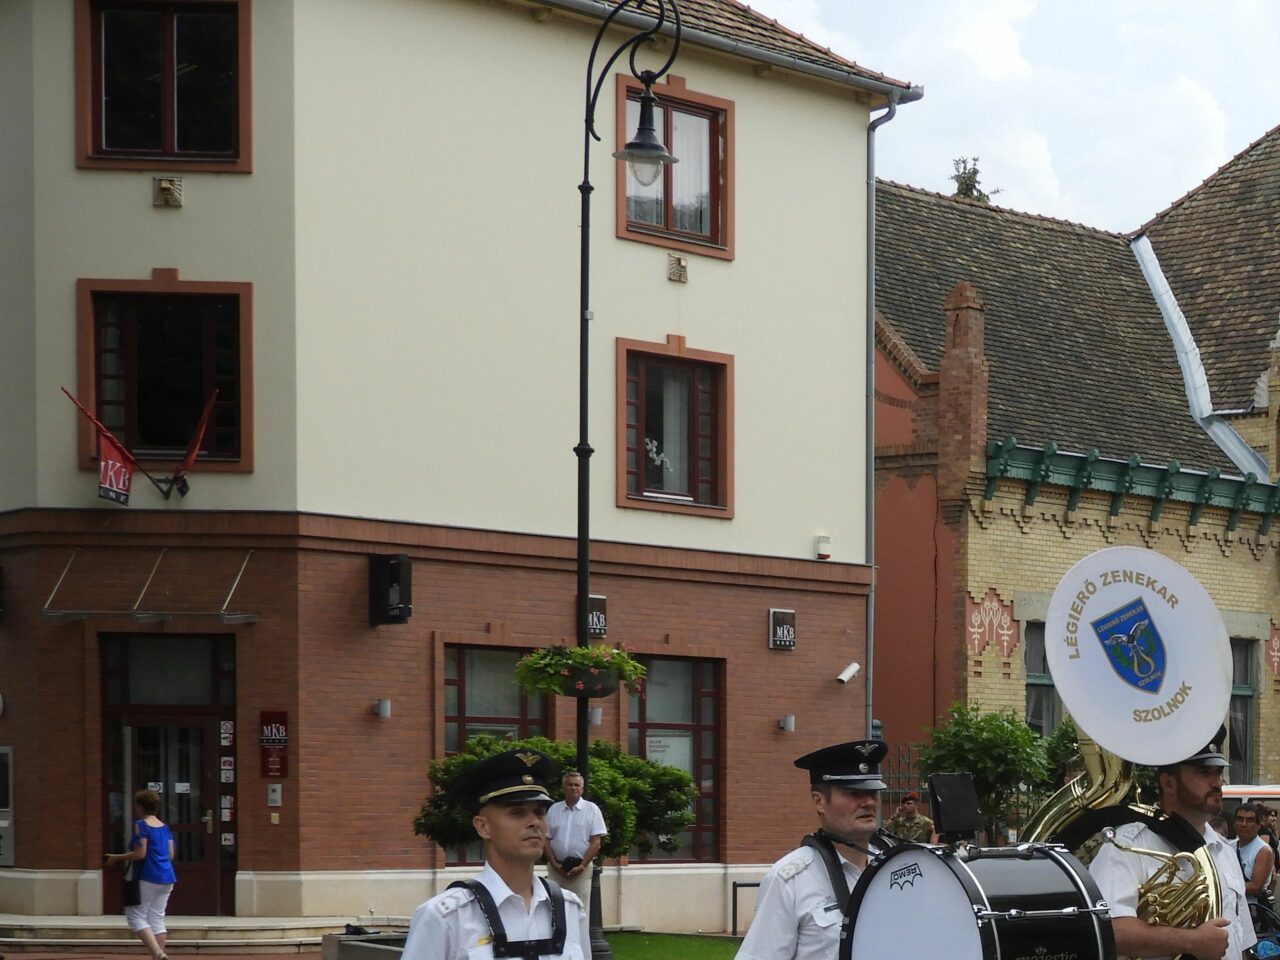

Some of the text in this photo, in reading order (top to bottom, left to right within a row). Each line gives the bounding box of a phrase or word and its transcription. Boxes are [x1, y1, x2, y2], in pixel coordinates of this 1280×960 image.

[1064, 569, 1179, 660] LÉGIERŐ ZENEKAR
[776, 625, 795, 640] MKB
[1133, 680, 1192, 723] SZOLNOK
[263, 724, 286, 738] MKB
[893, 866, 917, 881] REMO
